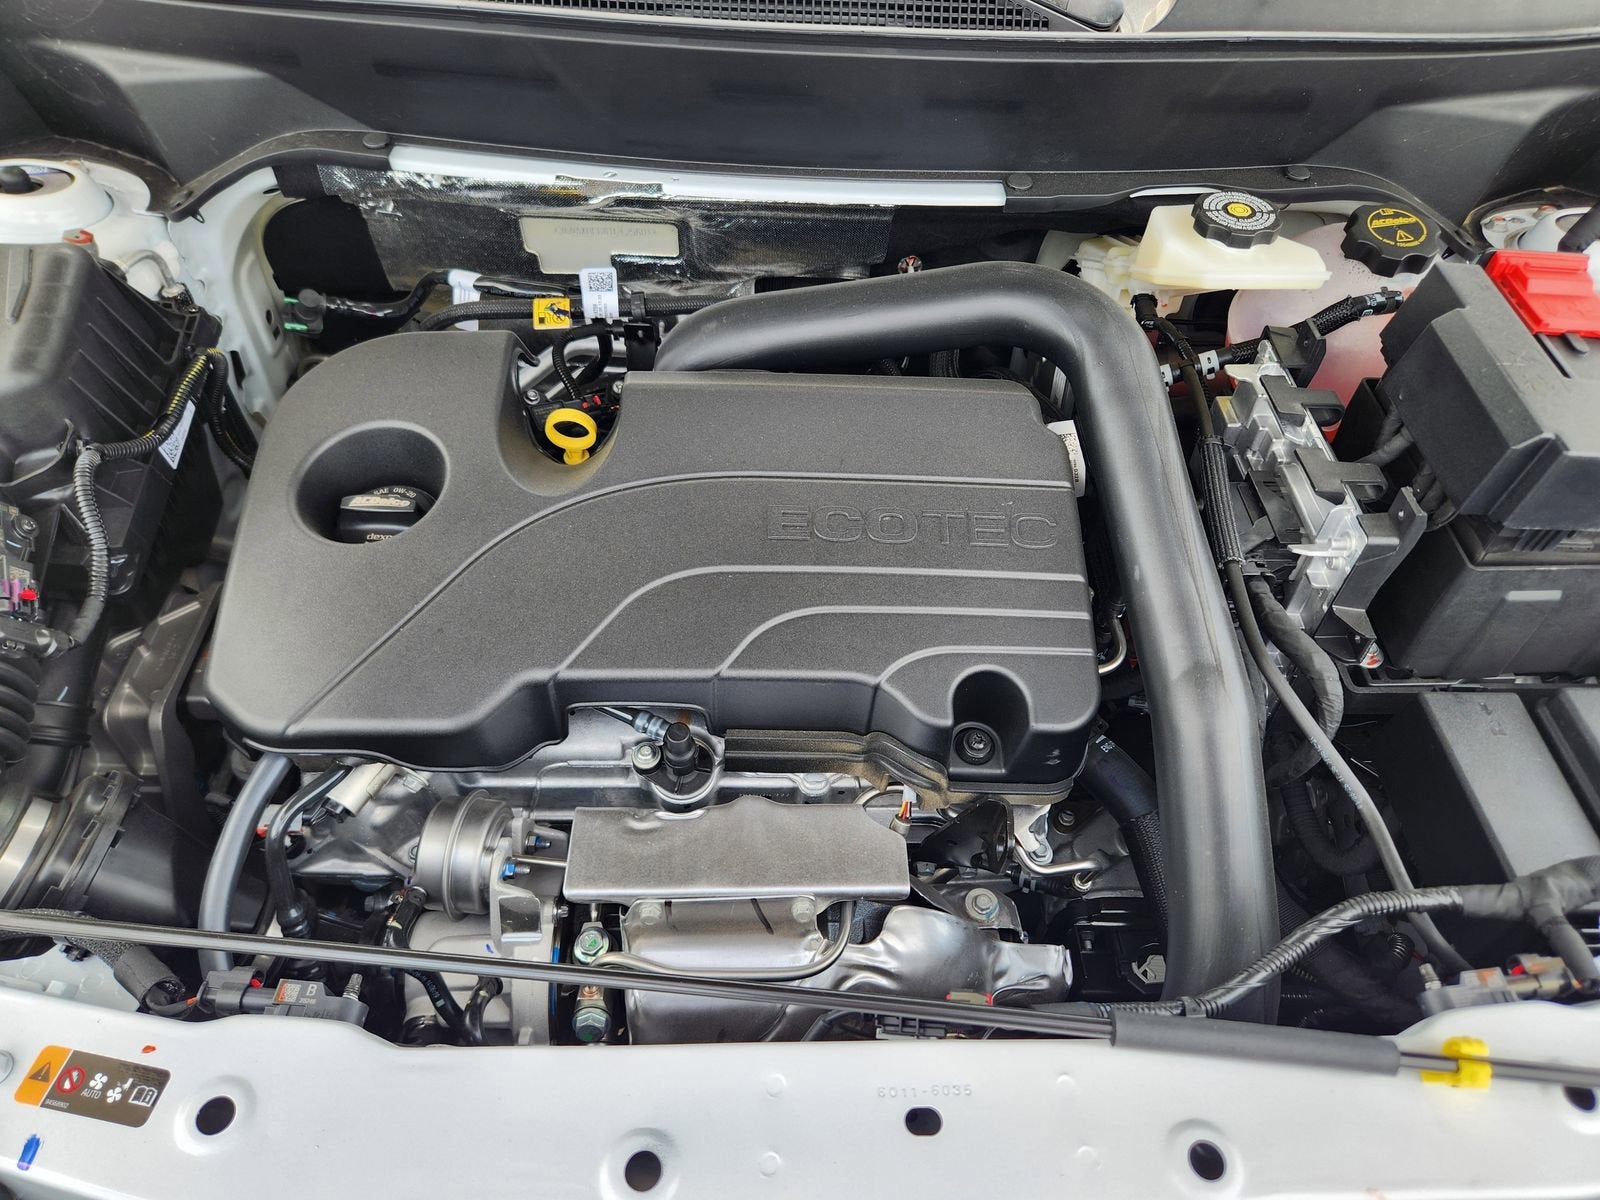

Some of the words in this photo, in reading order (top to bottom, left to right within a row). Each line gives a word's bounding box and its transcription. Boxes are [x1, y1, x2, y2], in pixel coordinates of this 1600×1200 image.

[373, 487, 389, 495] SAE
[393, 487, 417, 499] 0W-20
[767, 504, 1057, 549] ECOTEC
[306, 983, 318, 996] B
[80, 1088, 102, 1100] AUTO
